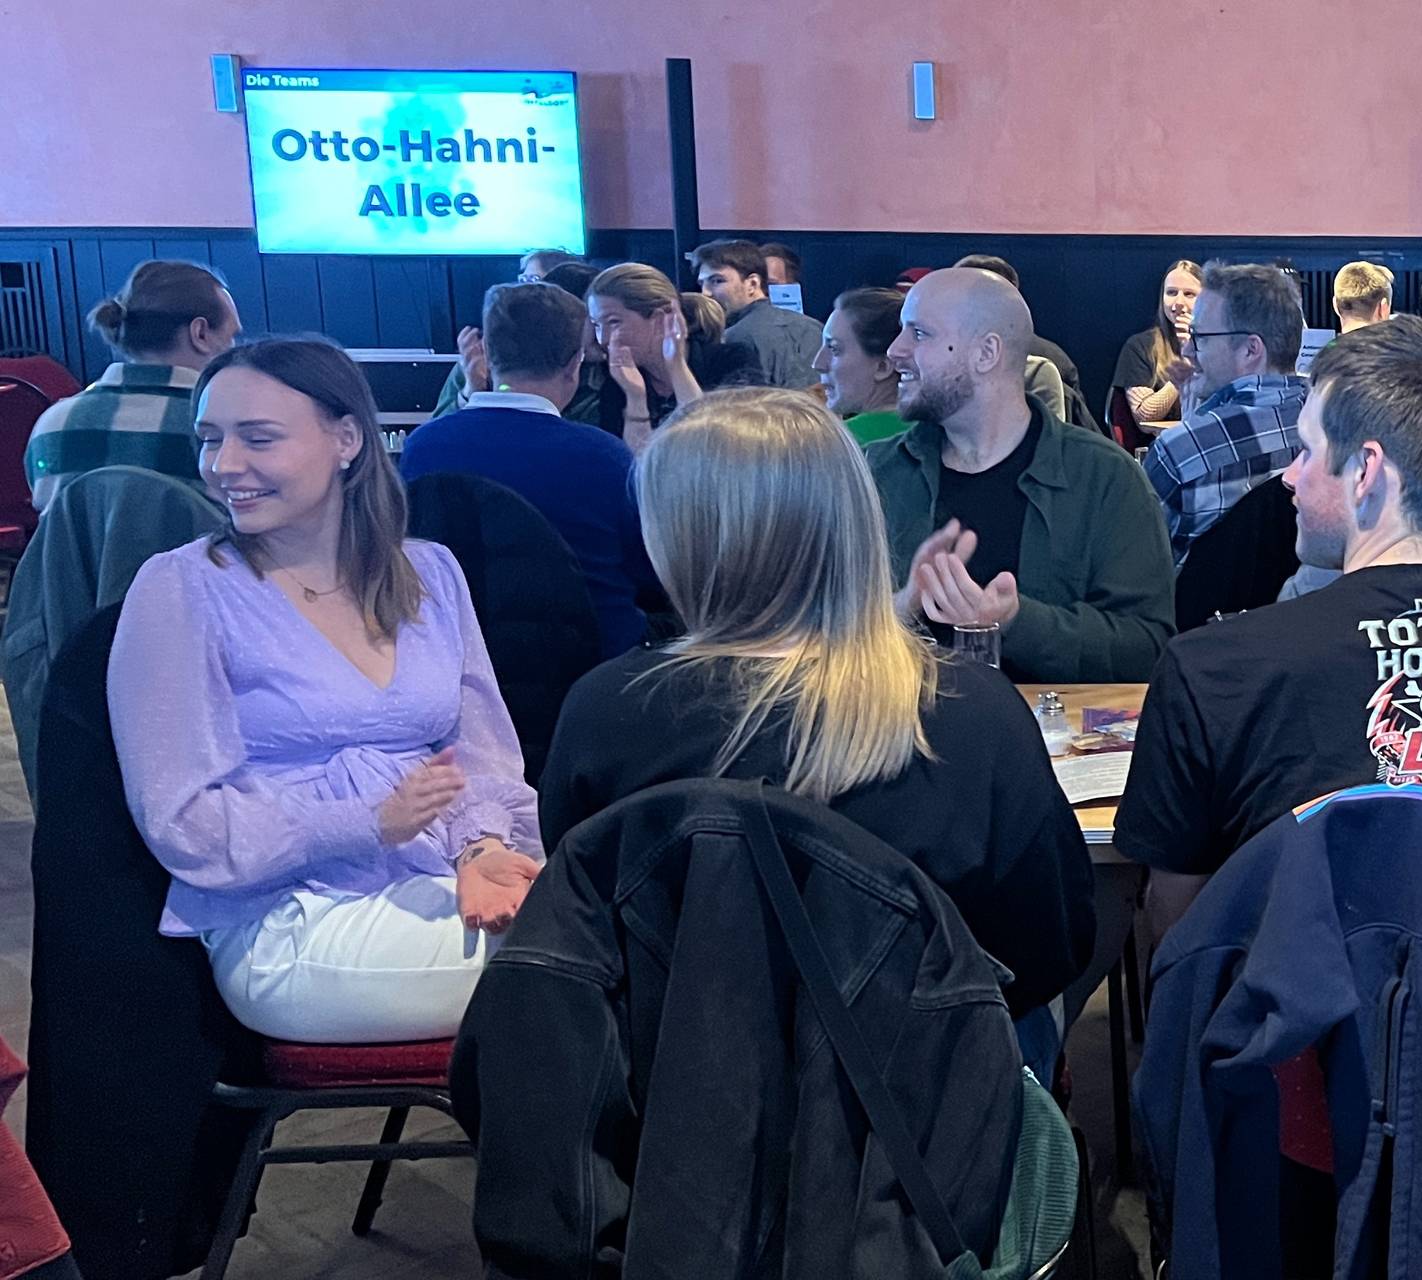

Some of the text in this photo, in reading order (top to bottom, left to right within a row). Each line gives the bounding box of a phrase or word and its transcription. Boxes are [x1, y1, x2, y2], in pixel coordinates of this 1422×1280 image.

[246, 74, 320, 87] Die Teams
[272, 127, 556, 163] Otto-Hahni-
[359, 183, 480, 217] Allee
